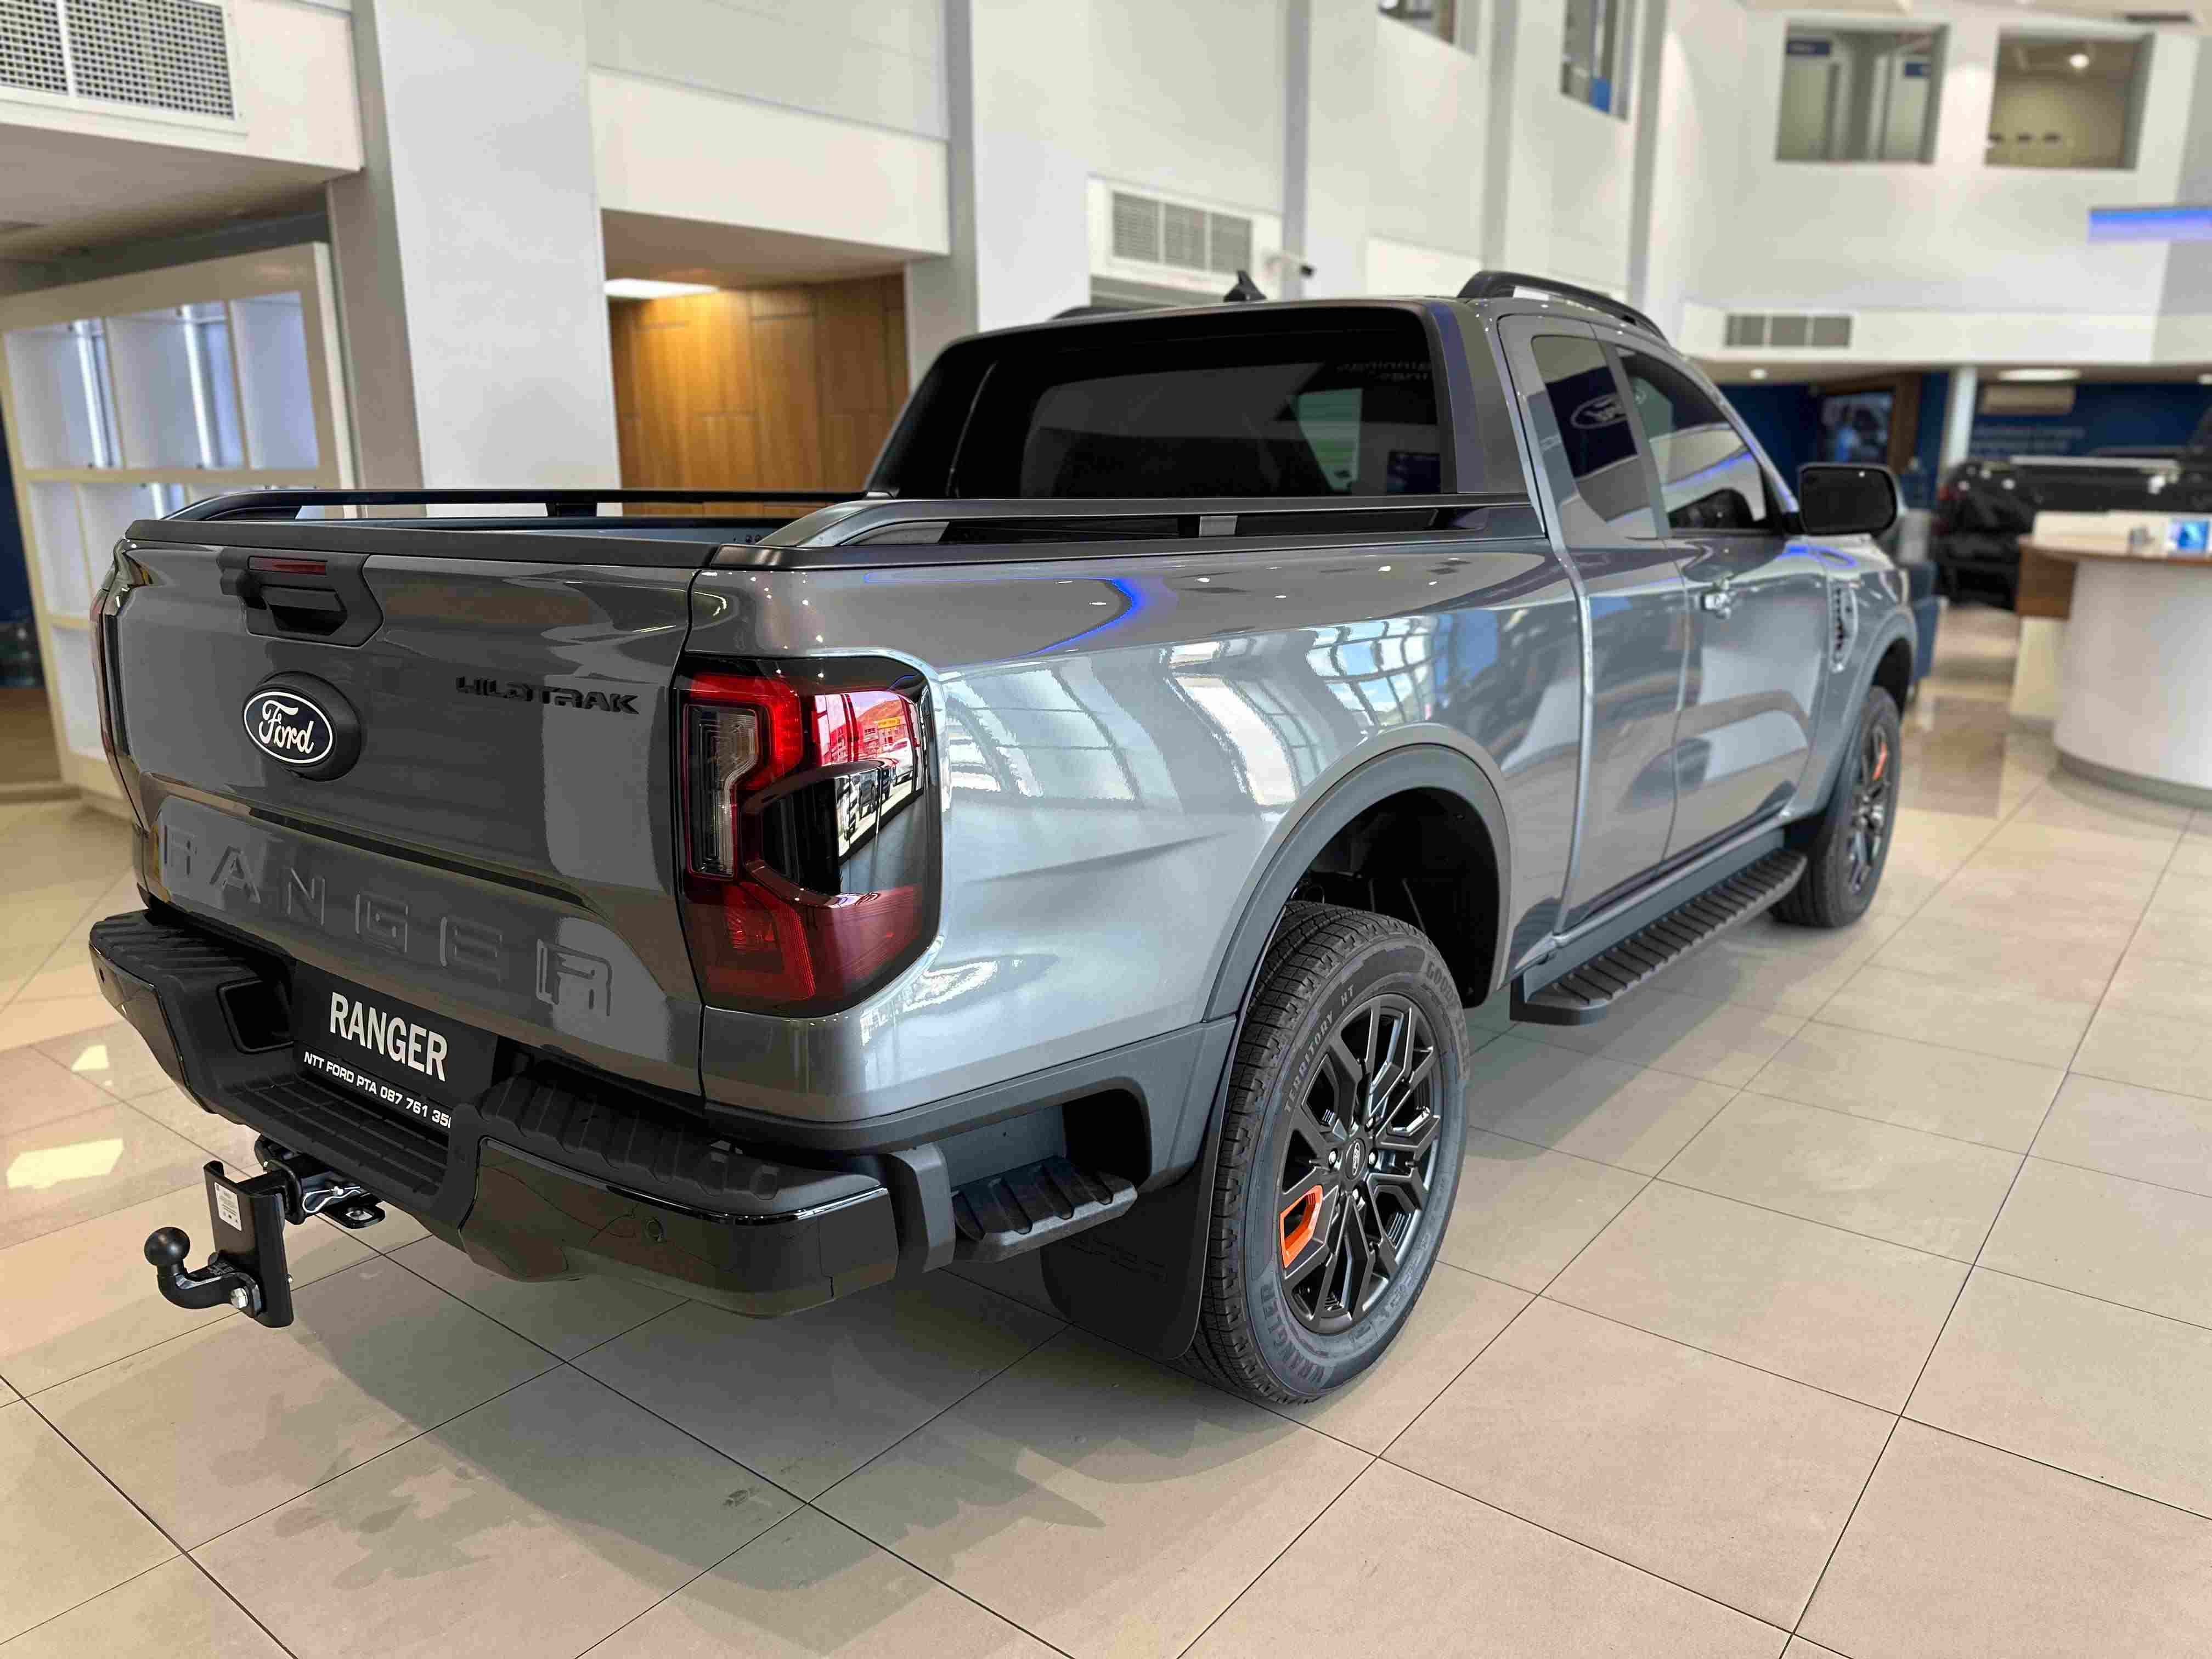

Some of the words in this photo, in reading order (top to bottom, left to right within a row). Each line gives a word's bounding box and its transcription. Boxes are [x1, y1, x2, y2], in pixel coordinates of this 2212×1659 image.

[258, 699, 314, 754] Ford
[164, 823, 613, 1017] RANGER
[330, 991, 448, 1082] RANGER
[1284, 1010, 1333, 1112] TERRITORY
[1340, 984, 1354, 1007] HT
[304, 1051, 324, 1069] NTT
[326, 1060, 354, 1084] FORD
[357, 1075, 377, 1095] PTA
[380, 1086, 403, 1105] 087
[406, 1097, 428, 1117] 761
[432, 1109, 452, 1128] 35
